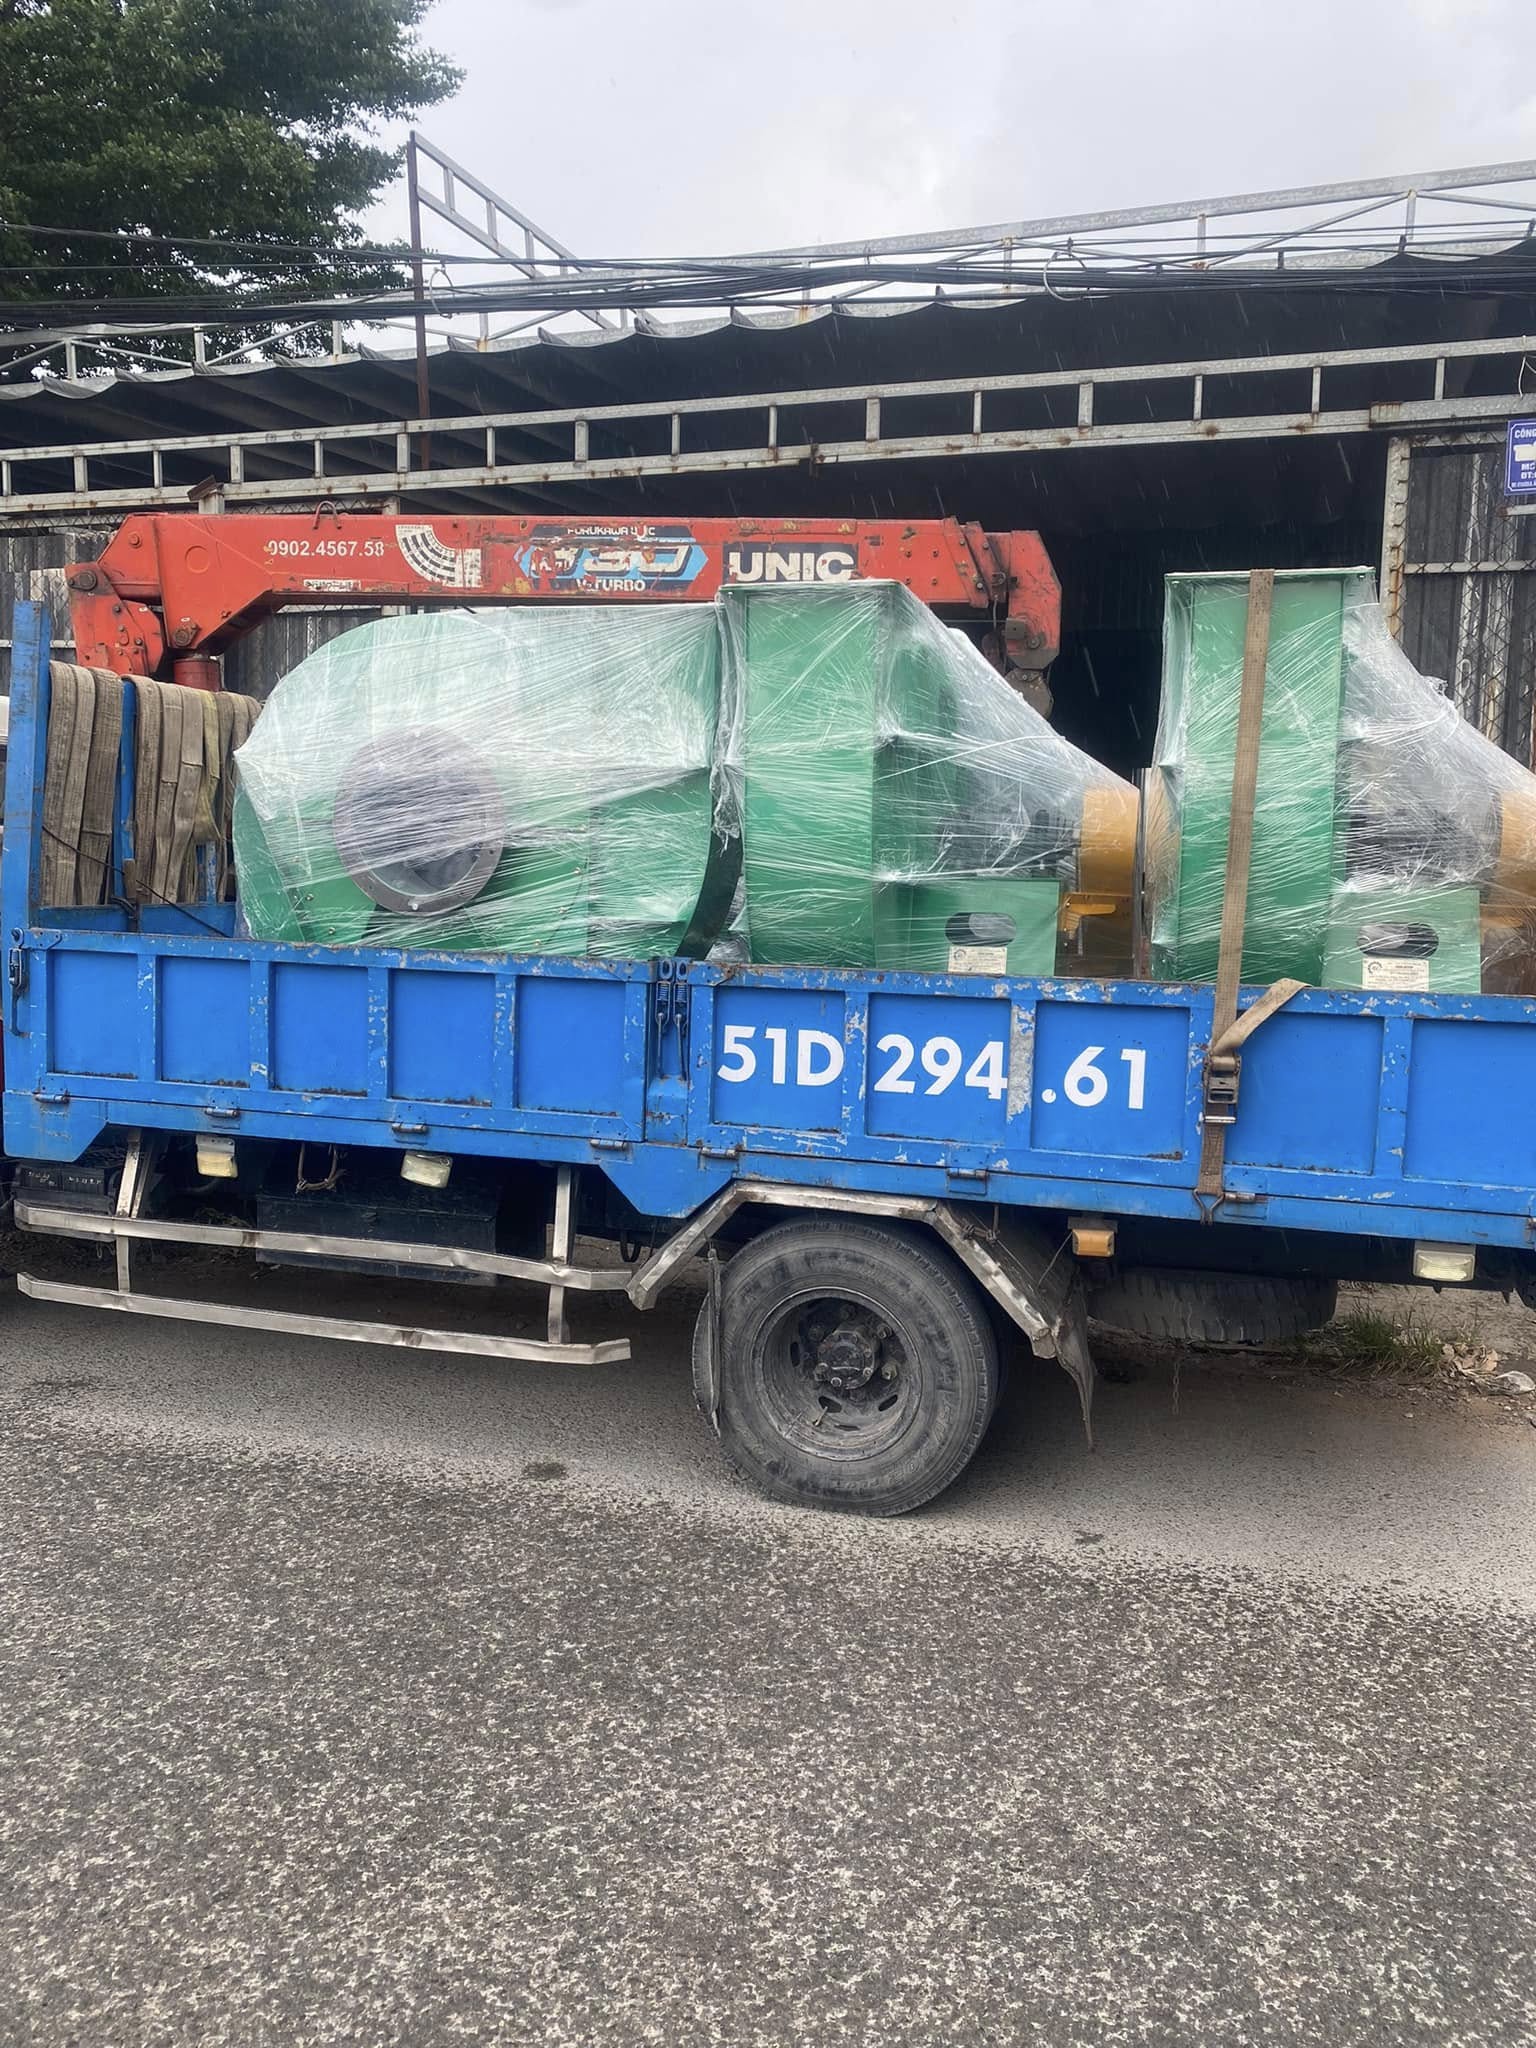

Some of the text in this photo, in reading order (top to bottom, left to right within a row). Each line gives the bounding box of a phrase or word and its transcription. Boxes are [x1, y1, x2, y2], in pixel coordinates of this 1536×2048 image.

[266, 540, 384, 556] 0902.4567.58
[729, 551, 854, 582] UNIC
[717, 1024, 1147, 1110] 51D 294 .61
